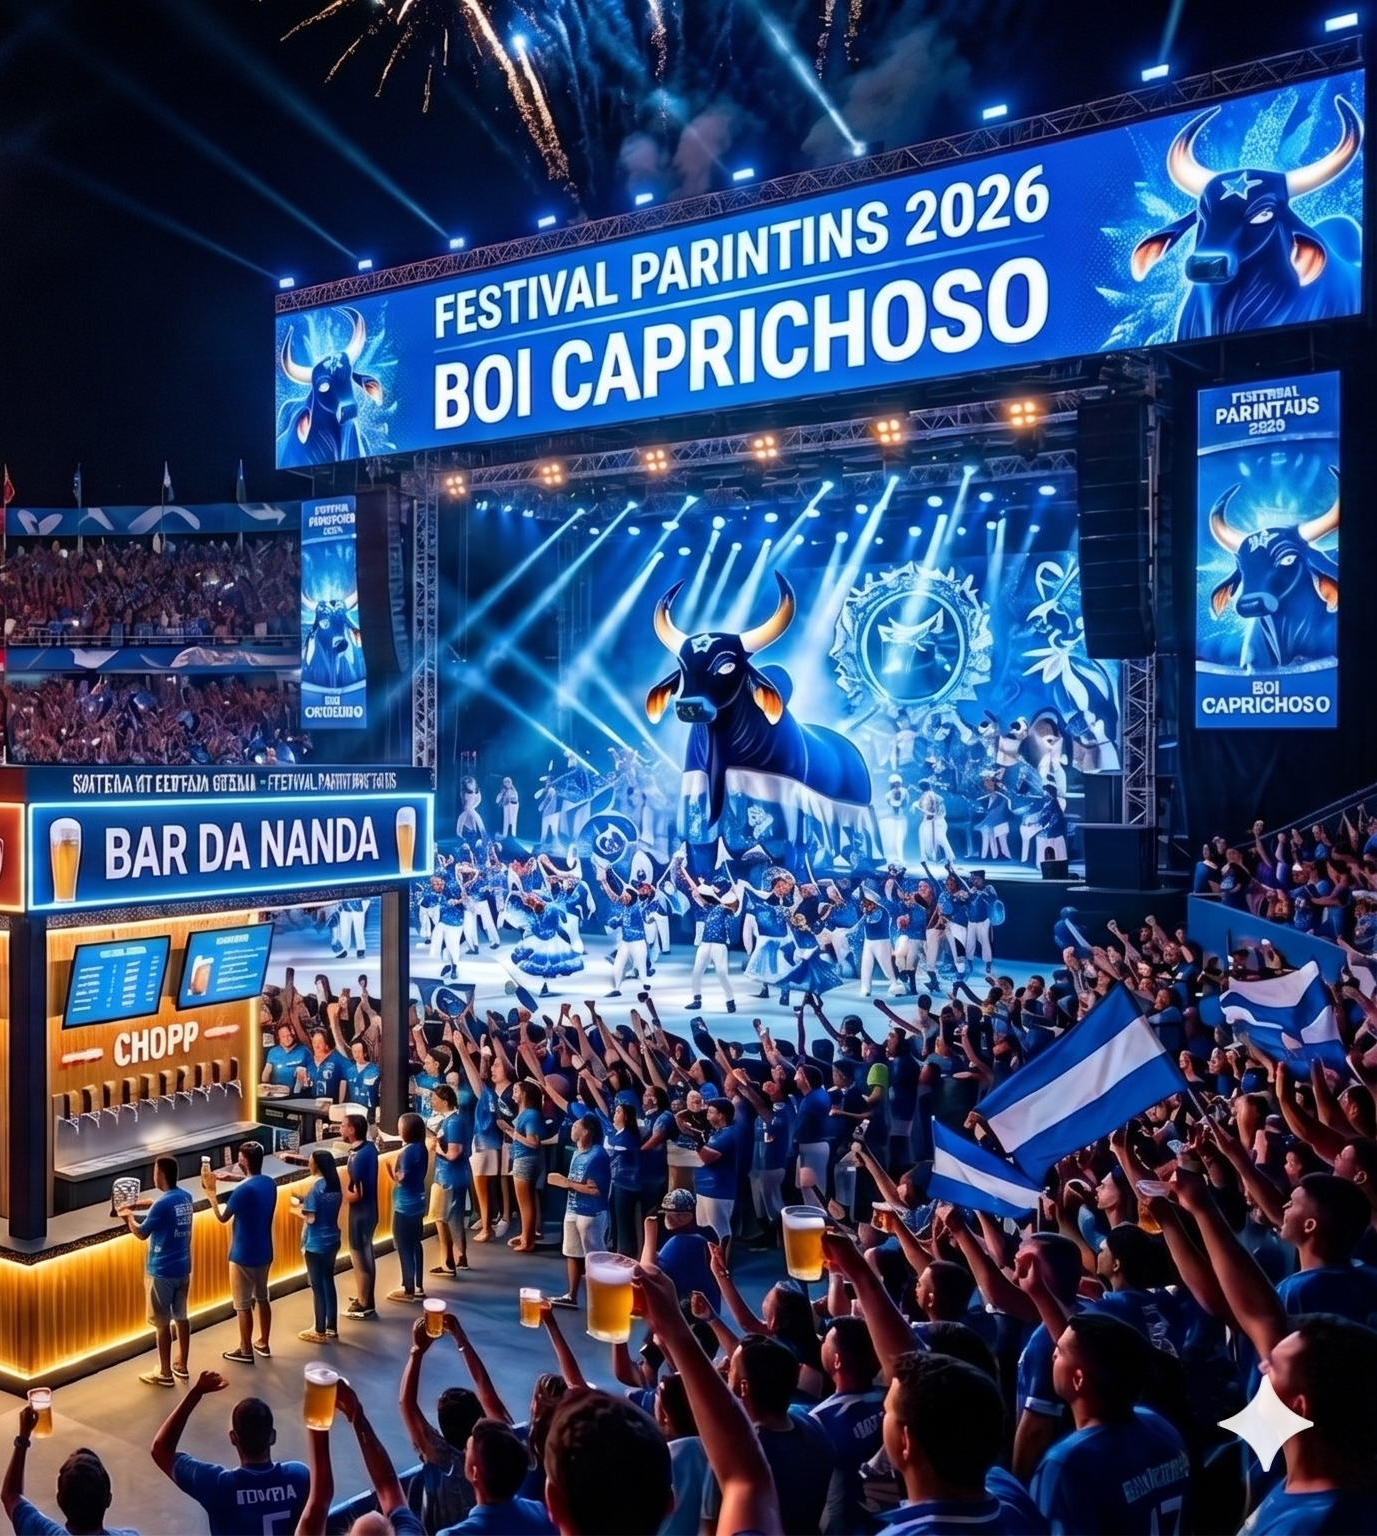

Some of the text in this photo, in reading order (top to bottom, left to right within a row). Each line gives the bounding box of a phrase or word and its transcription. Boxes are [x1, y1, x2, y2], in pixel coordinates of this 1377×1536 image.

[435, 164, 1050, 339] FESTIVAL PARINTINS 2026
[434, 257, 1050, 430] BOI CAPRICHOSO
[1202, 695, 1331, 714] CAPRICHOSO
[105, 816, 380, 880] BAR DA NANDA
[114, 1021, 199, 1067] CHOPP
